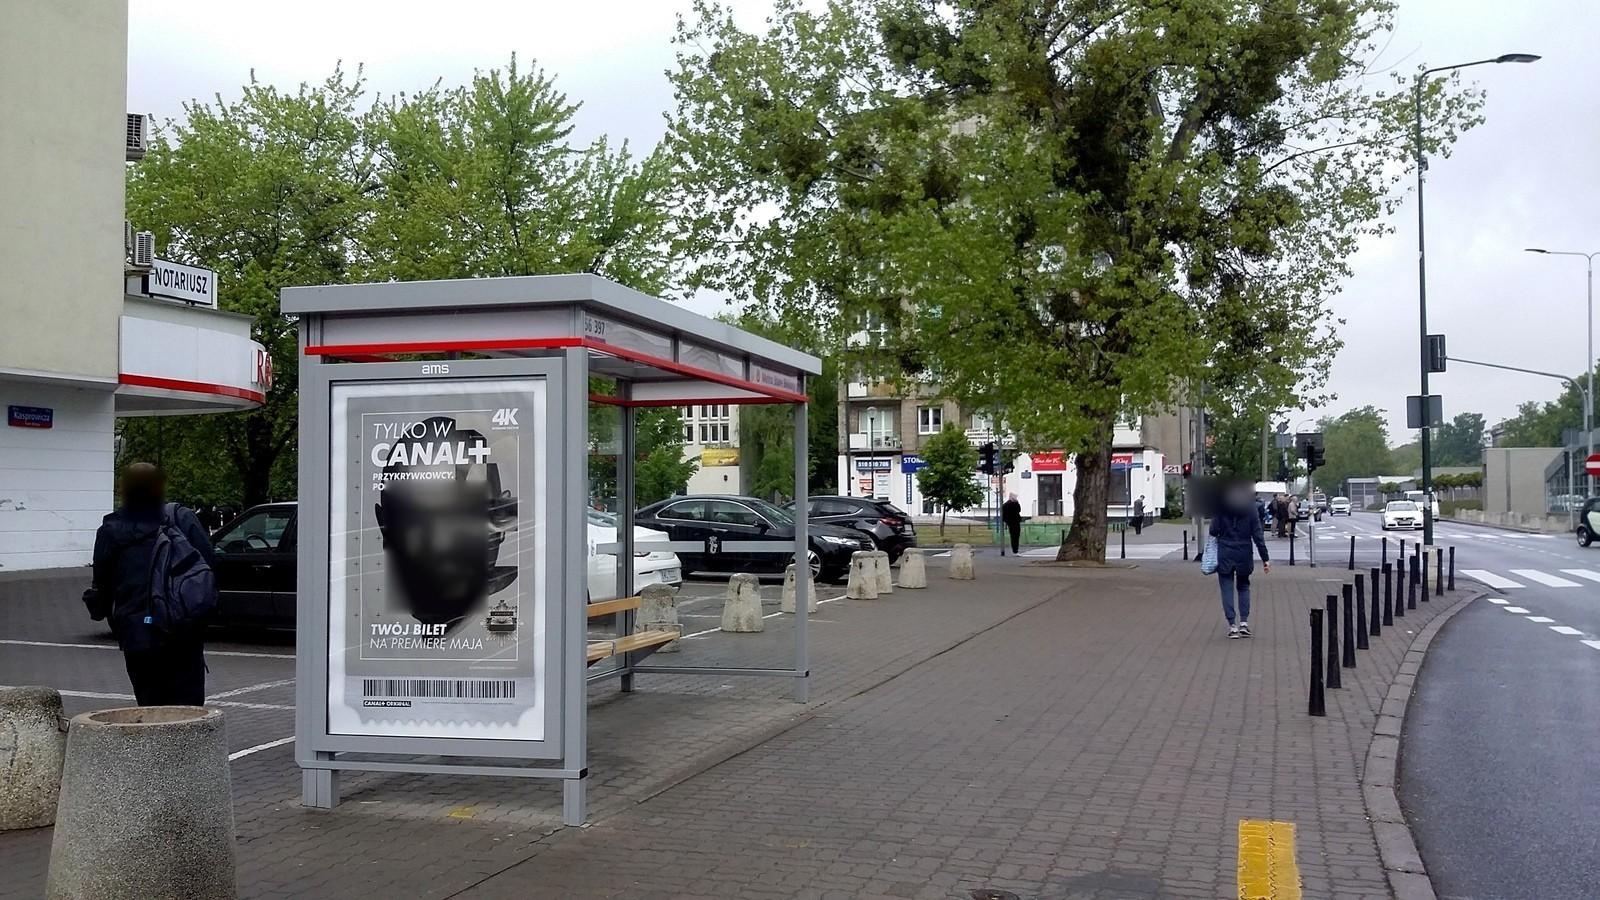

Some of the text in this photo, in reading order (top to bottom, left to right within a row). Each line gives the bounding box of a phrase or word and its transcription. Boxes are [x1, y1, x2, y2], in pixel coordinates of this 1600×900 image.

[155, 267, 207, 294] NOTARIUSZ
[594, 320, 605, 335] 397
[422, 364, 449, 374] ams
[492, 408, 519, 425] 4K
[373, 421, 453, 439] TYLKO W
[371, 440, 491, 467] CANAL+
[372, 472, 455, 481] PRZYKRYWKOWCY.
[372, 483, 386, 491] PO
[371, 622, 447, 635] TWÓJ BILET
[370, 638, 483, 651] NA PREMIERĘ MAJA
